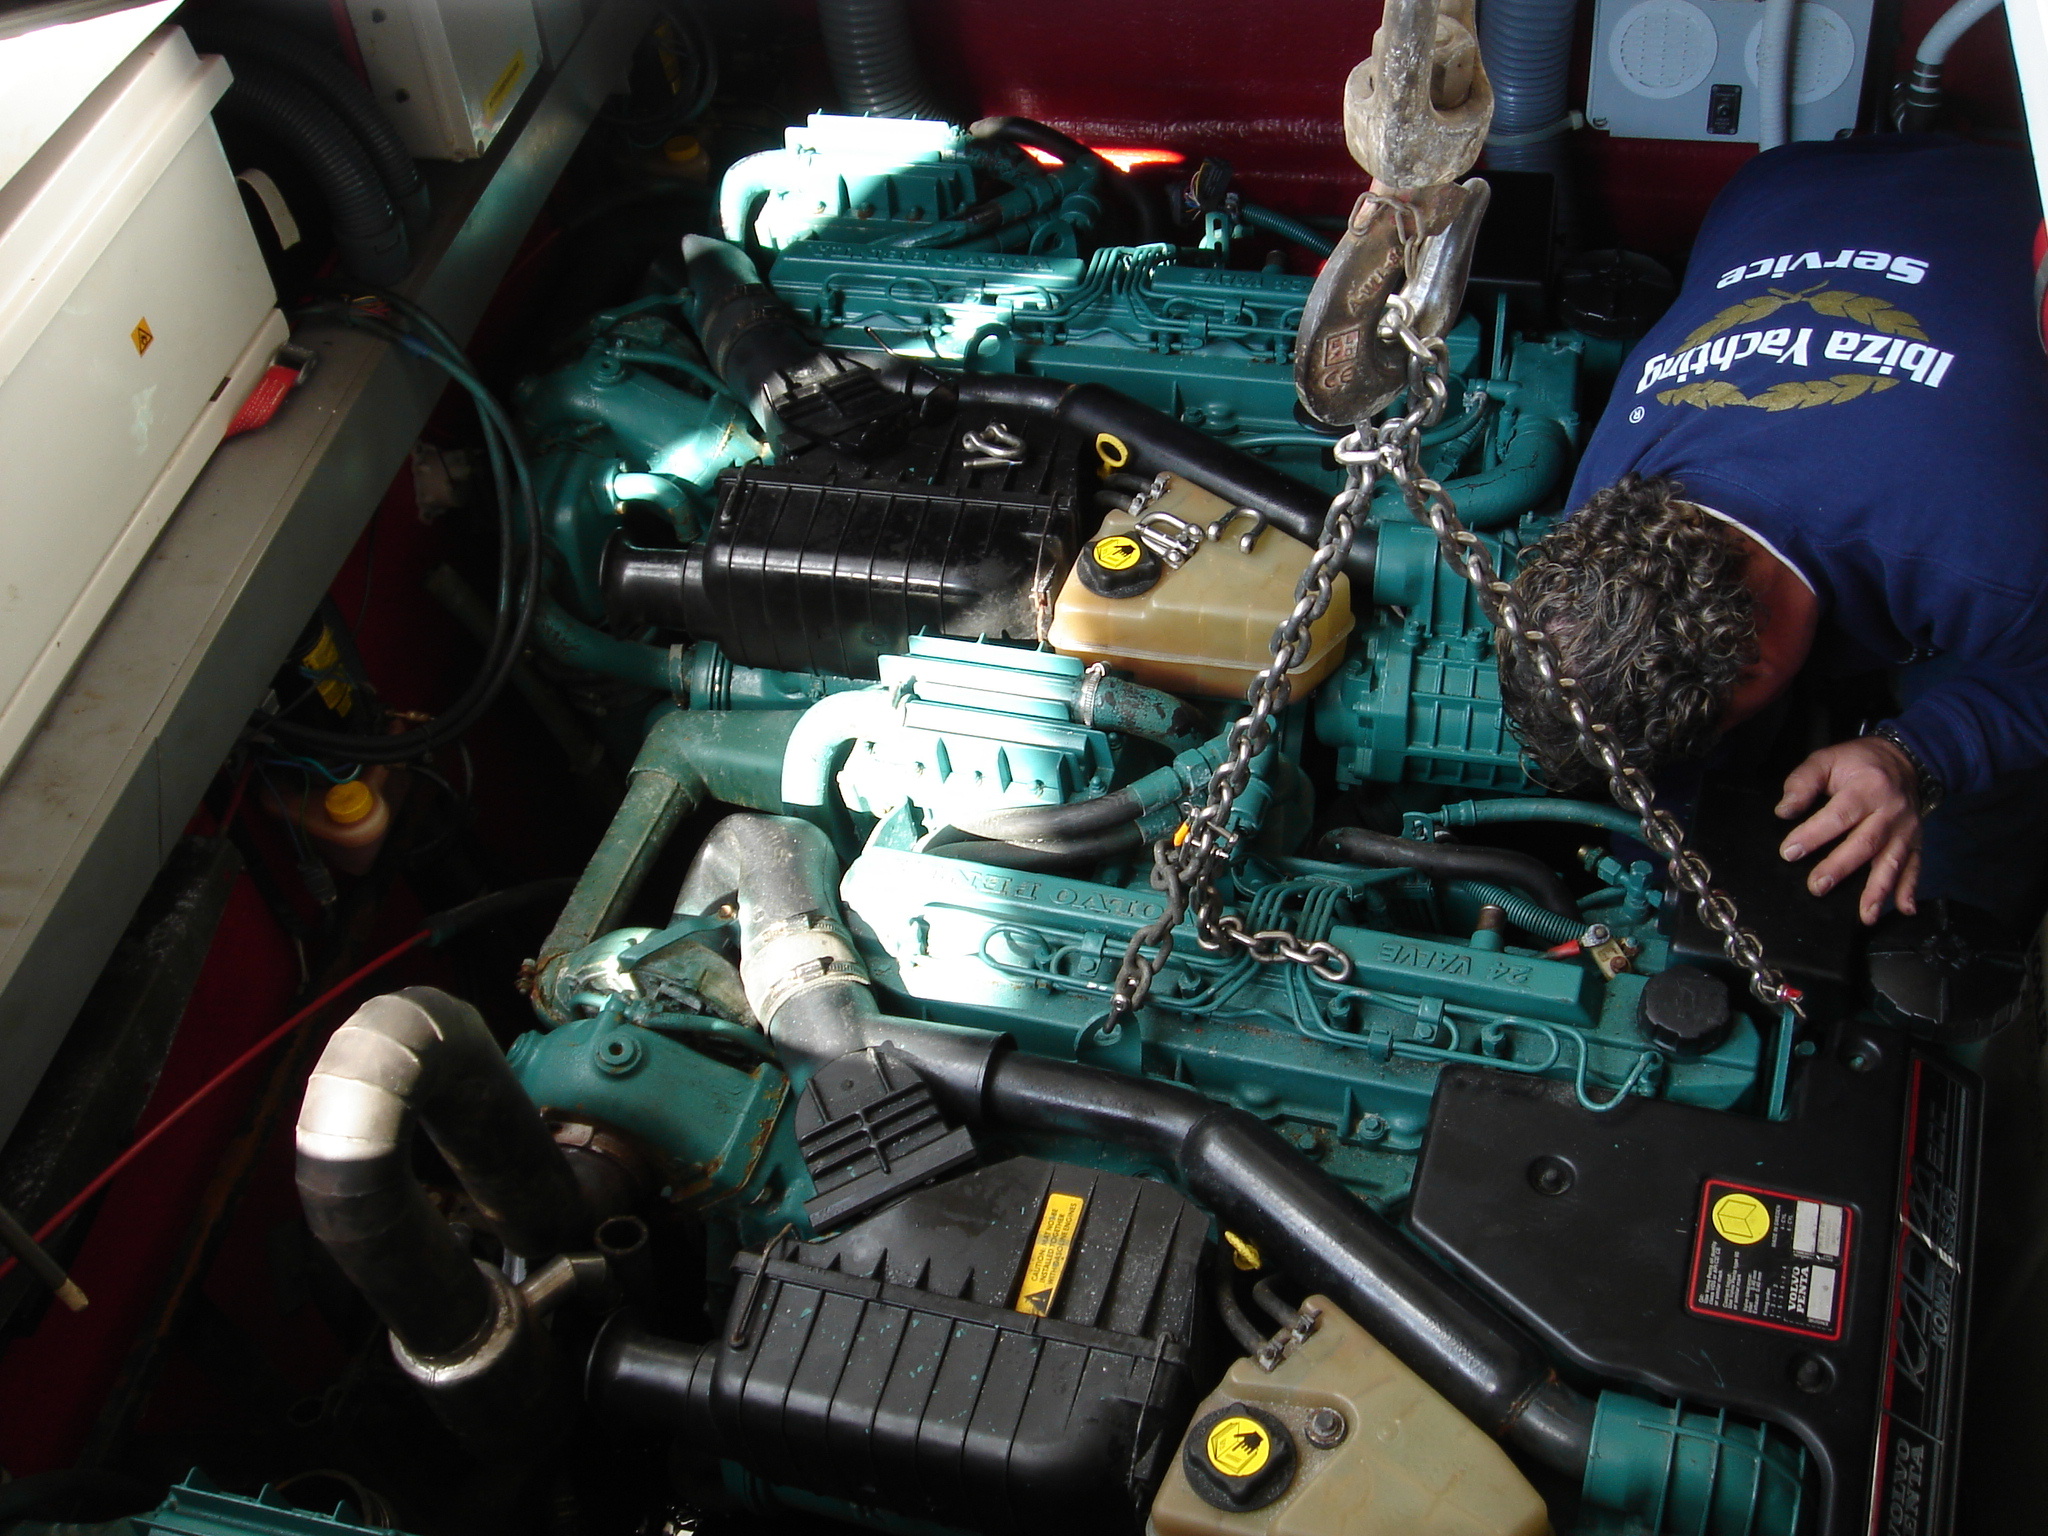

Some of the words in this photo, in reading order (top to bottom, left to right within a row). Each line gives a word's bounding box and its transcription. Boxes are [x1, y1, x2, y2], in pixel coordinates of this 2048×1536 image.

[1716, 250, 1929, 289] Service
[1636, 328, 1813, 394] Yachting
[1824, 330, 1954, 388] Ibiza
[1378, 942, 1472, 976] VALVE
[1488, 961, 1534, 989] 24
[1787, 1265, 1801, 1312] VOLVO
[1795, 1265, 1809, 1314] PENTA
[1902, 1444, 1925, 1536] ENTA
